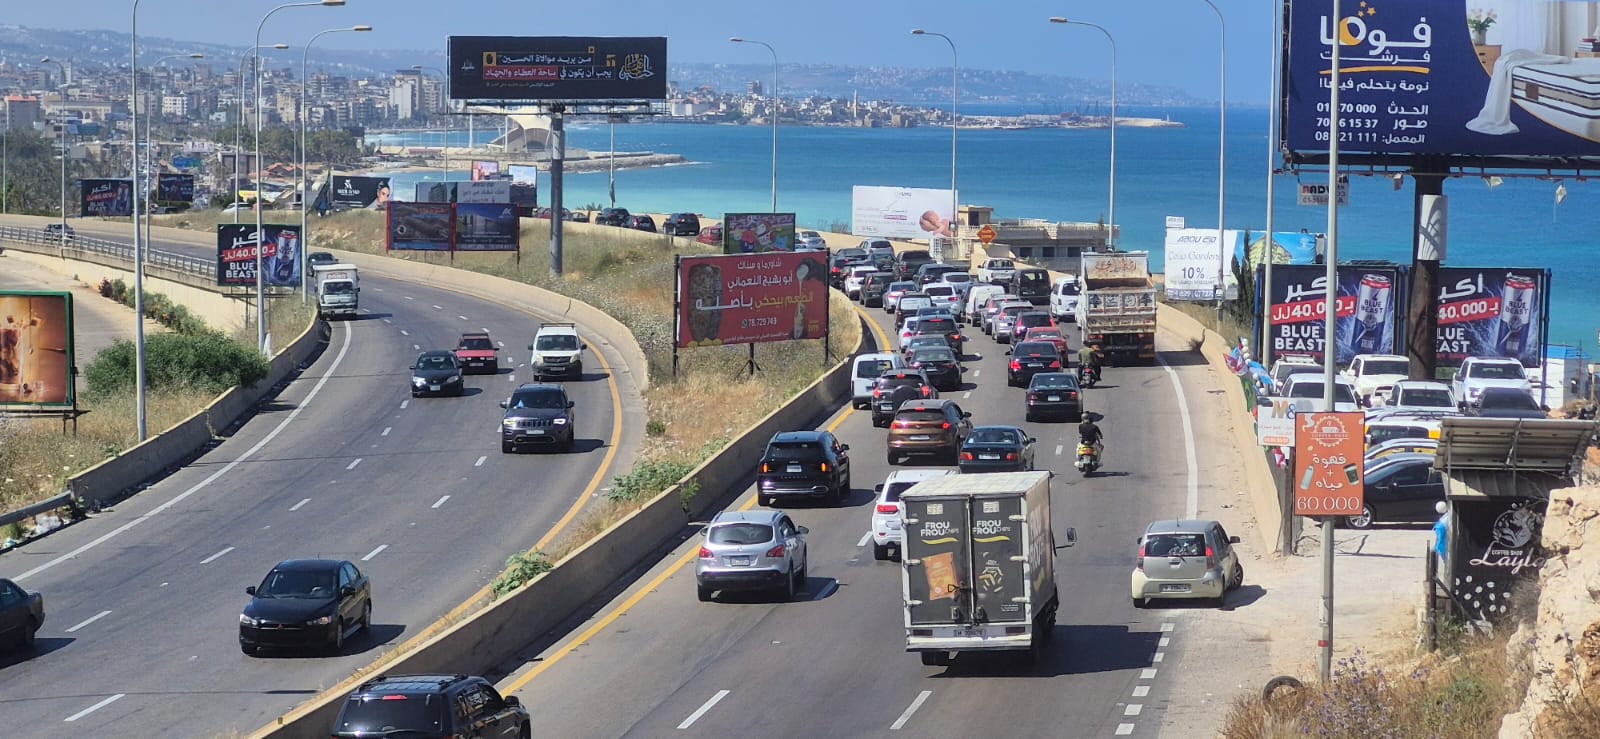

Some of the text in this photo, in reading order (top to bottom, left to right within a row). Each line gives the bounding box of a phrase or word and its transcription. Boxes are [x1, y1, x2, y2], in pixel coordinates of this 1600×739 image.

[501, 54, 534, 64] الحسين
[567, 68, 585, 79] يكون
[595, 69, 612, 79] يجب
[1319, 77, 1429, 93] نومة بتحلم فيا!
[1337, 103, 1354, 113] 70
[1355, 104, 1377, 113] 000
[1387, 100, 1429, 115] الحدث
[1316, 117, 1330, 127] 70
[1348, 118, 1362, 128] 15
[1363, 119, 1379, 129] 37
[1393, 119, 1428, 131] صور
[1314, 131, 1329, 141] 08
[1357, 132, 1377, 142] 111
[229, 262, 255, 270] BLUE
[225, 270, 258, 278] BEAST
[1281, 324, 1320, 338] BLUE
[1436, 327, 1465, 340] LUE
[1274, 337, 1326, 351] BEAST
[1435, 340, 1471, 353] AST
[1312, 453, 1347, 469] قهوة
[1315, 478, 1344, 491] مياه
[1297, 496, 1360, 511] 60 000
[925, 521, 950, 529] FROU
[976, 519, 1002, 528] FROU
[920, 528, 945, 537] FROU
[972, 526, 997, 535] FROU
